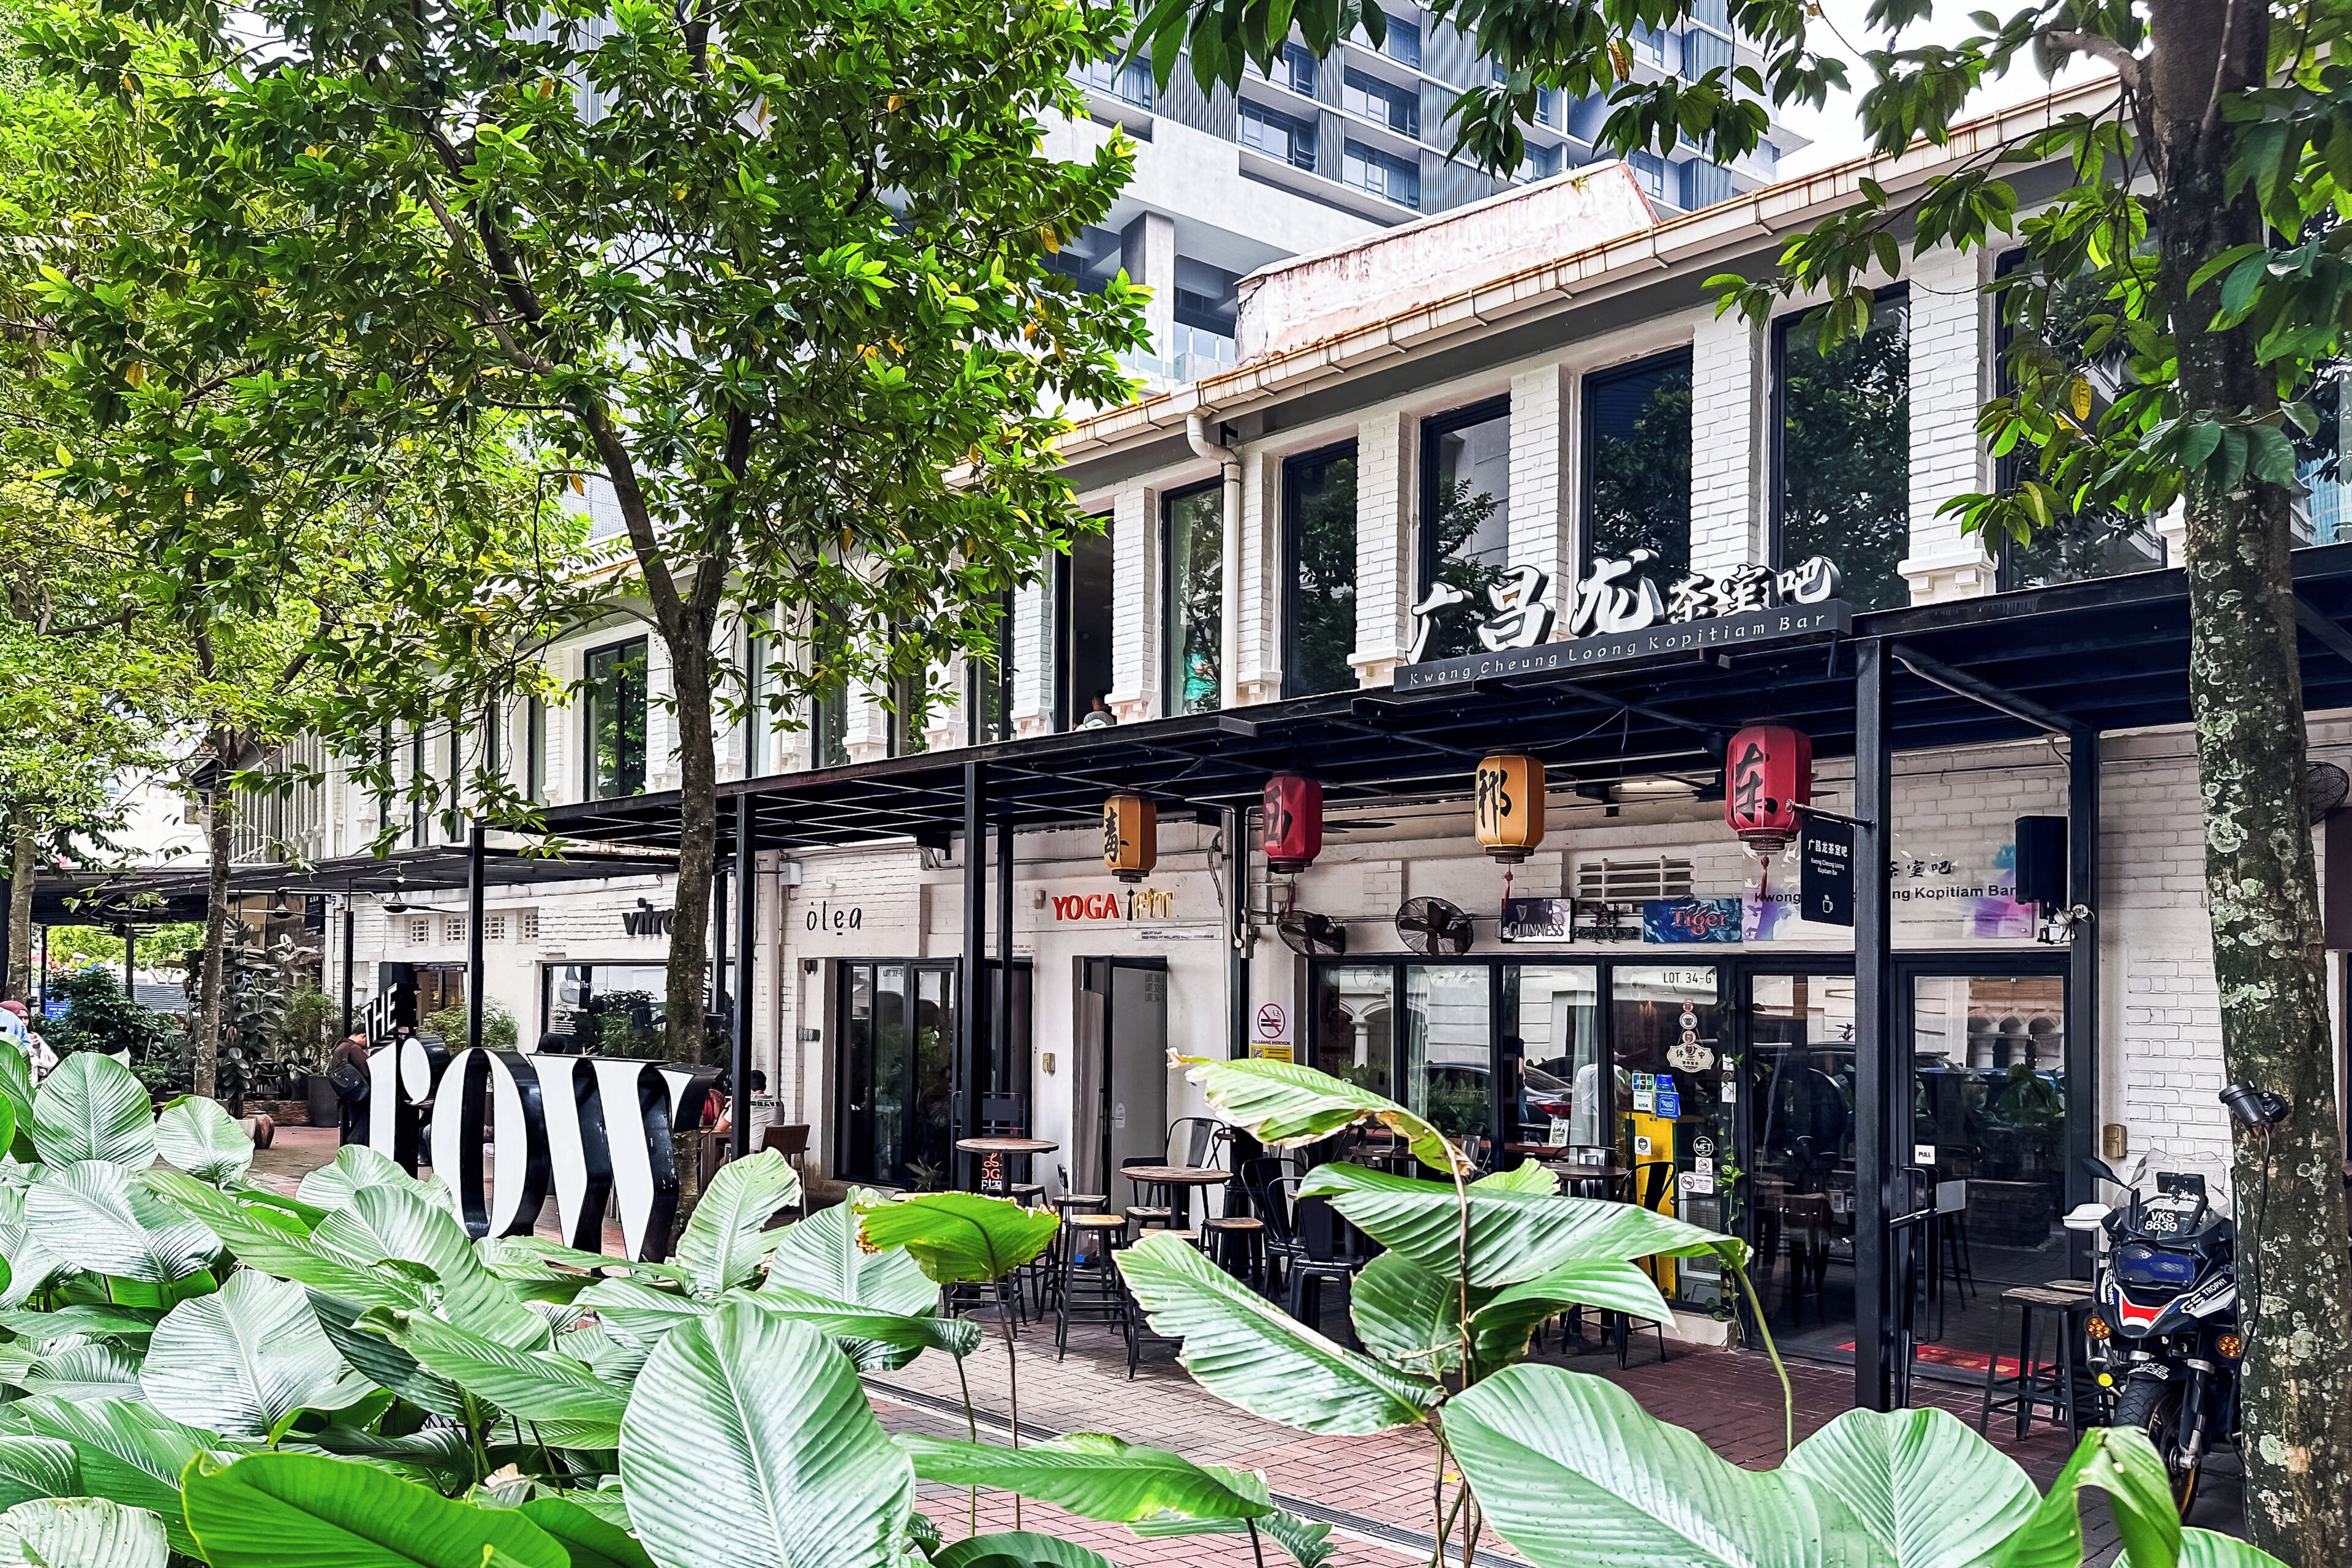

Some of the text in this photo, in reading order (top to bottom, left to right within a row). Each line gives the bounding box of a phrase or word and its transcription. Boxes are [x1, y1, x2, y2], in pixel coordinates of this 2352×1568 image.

[1409, 614, 1825, 685] Kwong Cheung Loong Kopitiam Bar
[1915, 886, 1983, 901] Kopitiam
[1050, 892, 1120, 921] YOGA
[1672, 905, 1730, 936] Tiger
[361, 982, 398, 1047] THE
[2144, 1220, 2178, 1232] 8639
[2151, 1212, 2175, 1223] VKS
[2201, 1277, 2228, 1297] TROPHY
